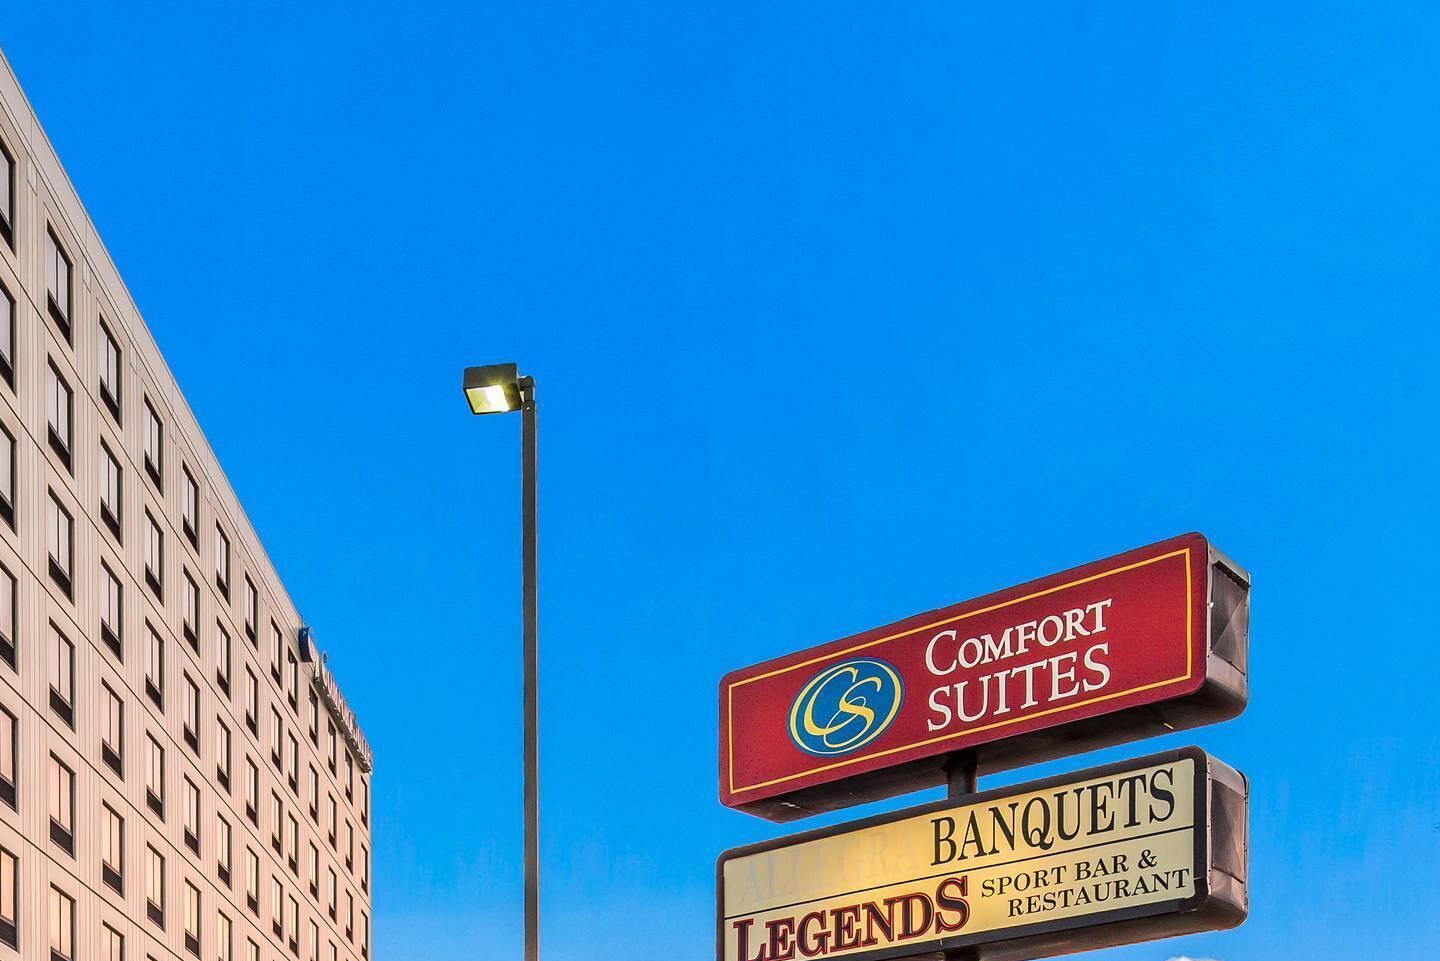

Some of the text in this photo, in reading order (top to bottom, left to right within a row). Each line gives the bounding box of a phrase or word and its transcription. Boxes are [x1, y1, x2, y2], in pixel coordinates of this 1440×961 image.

[925, 598, 1112, 676] COMFORT
[926, 642, 1112, 732] SUITES
[930, 768, 1175, 867] BANQUETS
[981, 849, 1158, 898] SPORT BAR &
[1007, 868, 1190, 918] RESTAURANT
